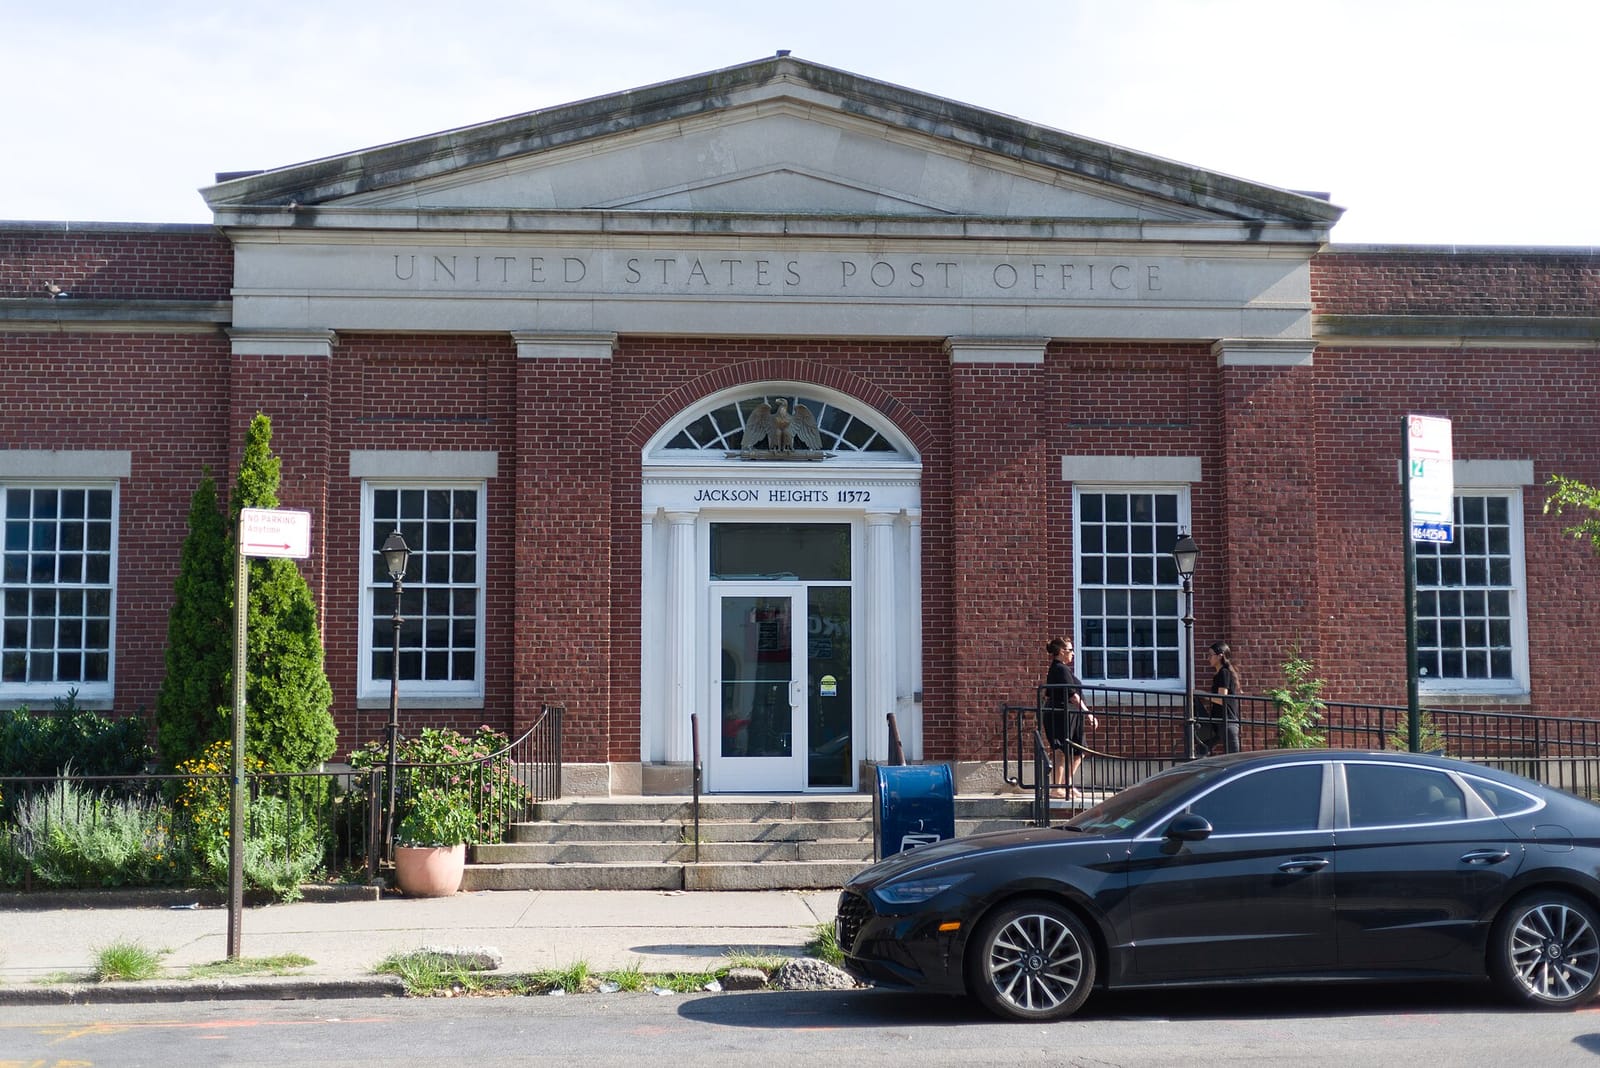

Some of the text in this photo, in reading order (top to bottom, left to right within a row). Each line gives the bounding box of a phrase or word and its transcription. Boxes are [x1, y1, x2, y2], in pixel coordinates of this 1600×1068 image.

[393, 254, 1163, 292] UNITED STATES POST OFFICE
[693, 489, 871, 503] JACKSON HEIGHTS 11372
[247, 514, 297, 525] NO PARKING
